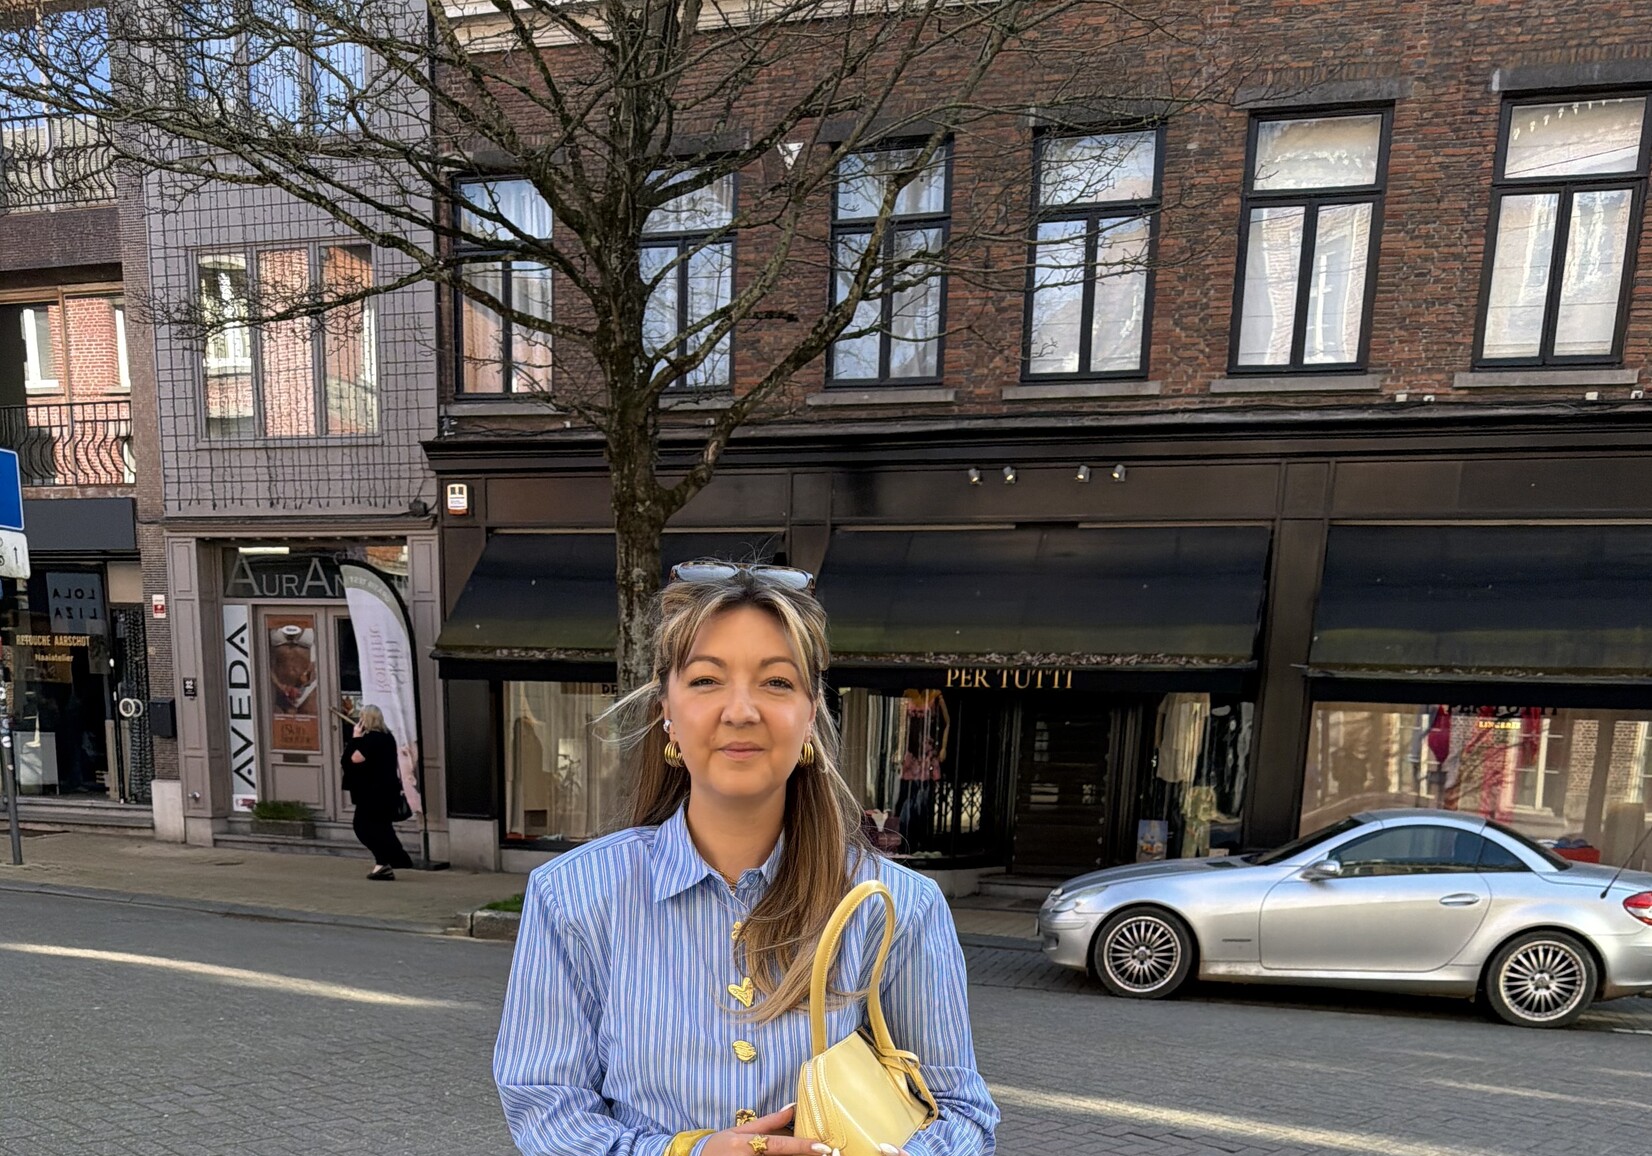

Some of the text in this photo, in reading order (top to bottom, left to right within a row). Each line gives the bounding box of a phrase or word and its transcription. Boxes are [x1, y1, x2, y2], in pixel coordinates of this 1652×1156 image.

[15, 634, 91, 647] RETOUCHE AARSCHOT
[945, 668, 1073, 689] PER TUTTI
[225, 622, 256, 789] AVEDA
